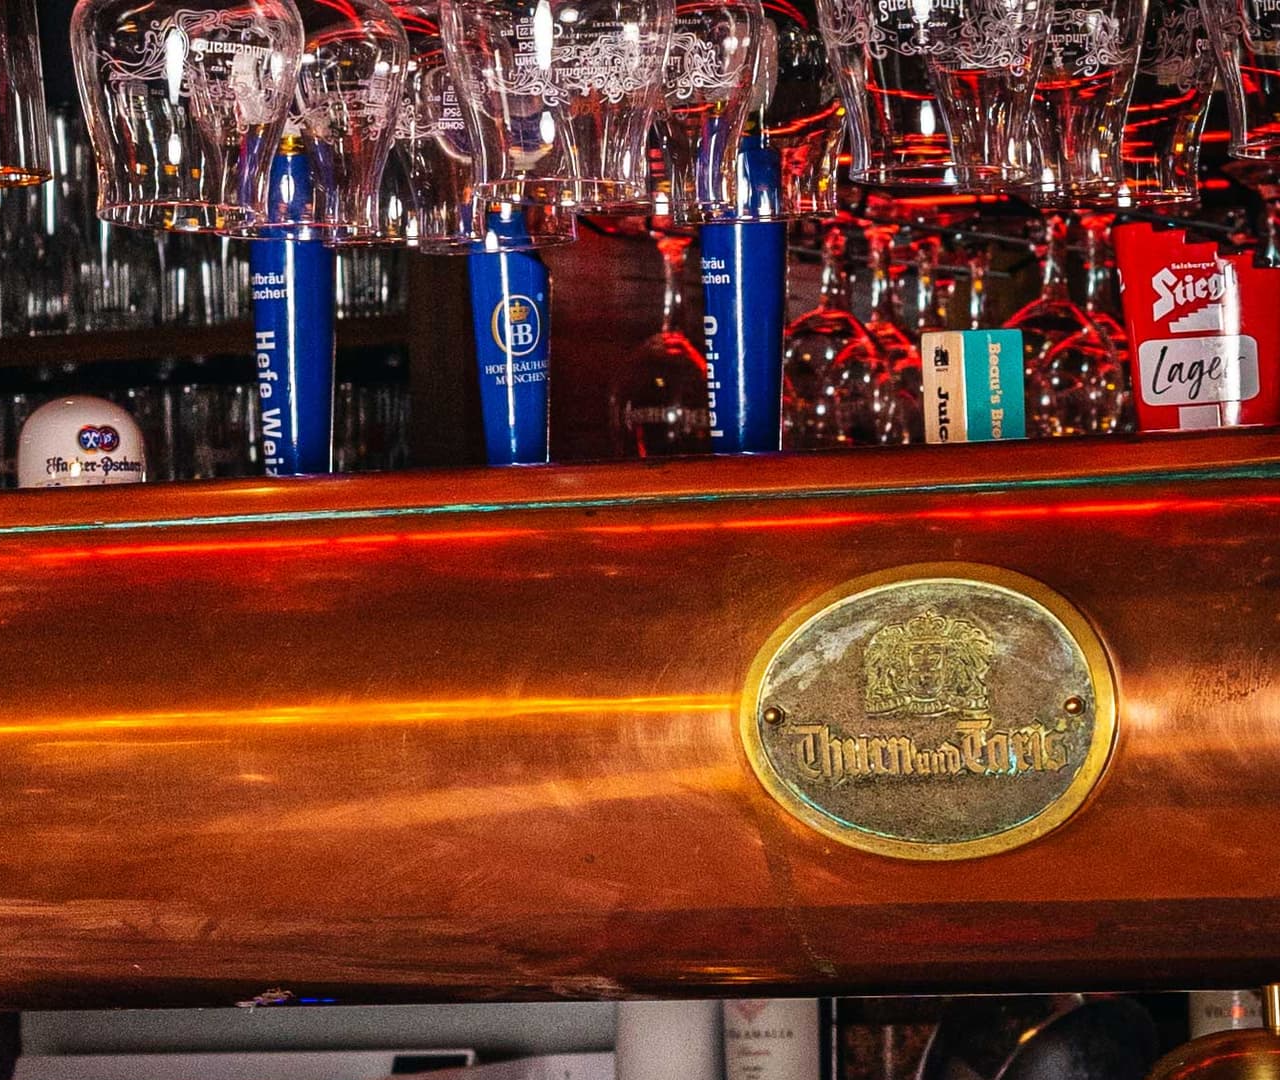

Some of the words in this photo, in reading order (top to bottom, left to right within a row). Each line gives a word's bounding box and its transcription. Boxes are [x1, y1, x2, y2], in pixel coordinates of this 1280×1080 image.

[1151, 263, 1236, 322] Stiegl
[255, 331, 279, 399] Hefe
[495, 371, 547, 386] MNCHEN
